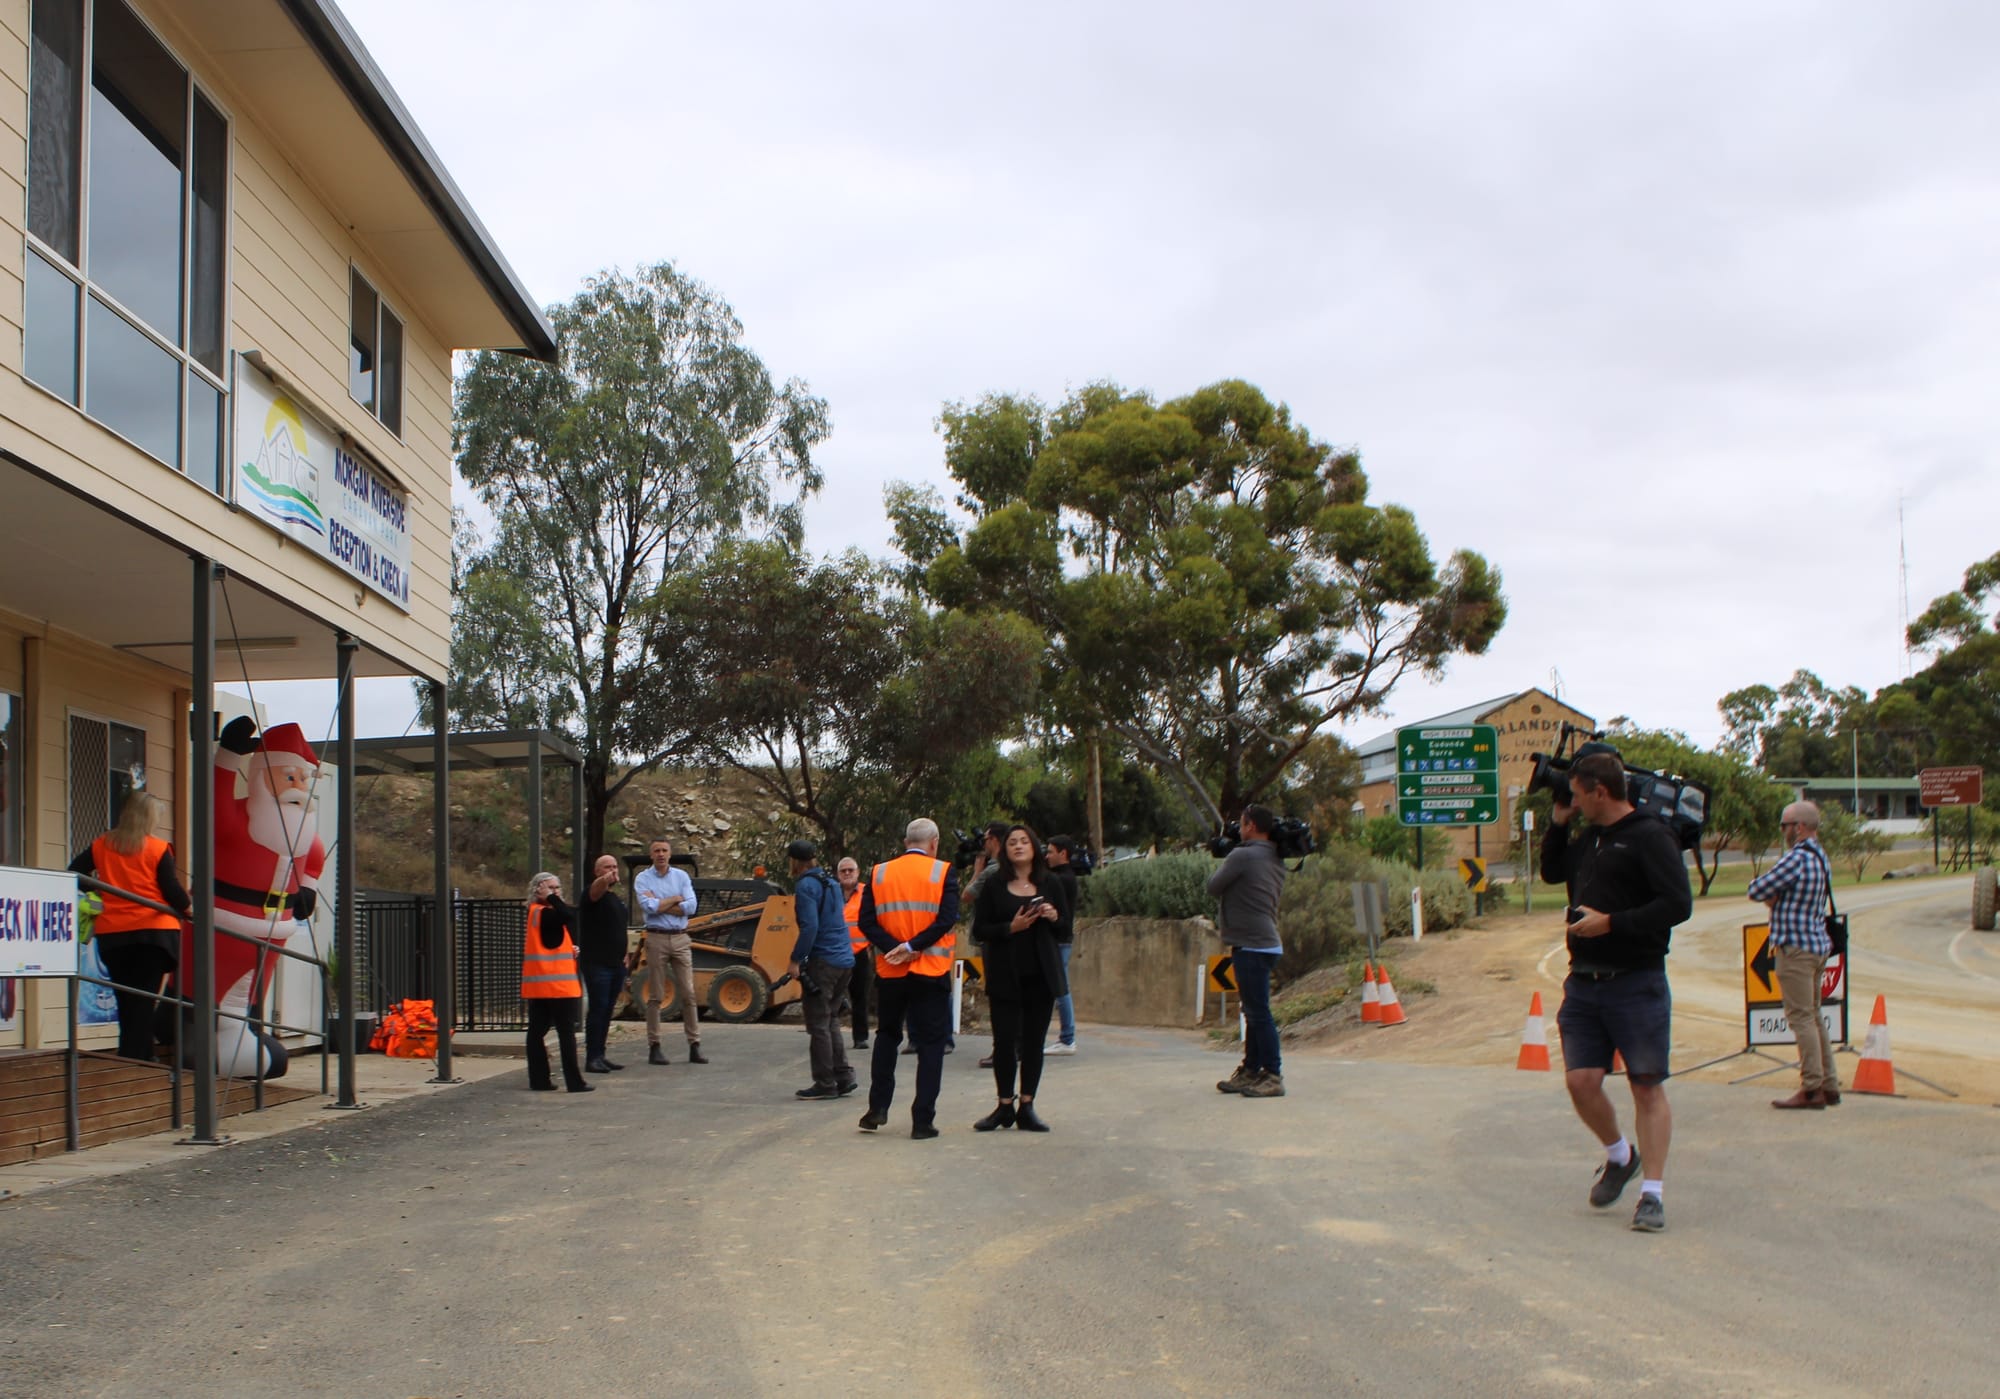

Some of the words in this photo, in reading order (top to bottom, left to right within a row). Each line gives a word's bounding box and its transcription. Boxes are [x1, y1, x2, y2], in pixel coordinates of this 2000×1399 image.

[335, 447, 369, 504] MORGAN
[371, 475, 405, 533] RIVERSIDE
[329, 517, 372, 577] RECEPTION
[373, 552, 379, 582] &
[380, 554, 401, 599] CHECK
[401, 570, 409, 604] IN
[1442, 729, 1470, 737] STREET
[25, 899, 39, 942] IN
[42, 901, 73, 942] HERE
[1760, 1017, 1787, 1034] ROAD
